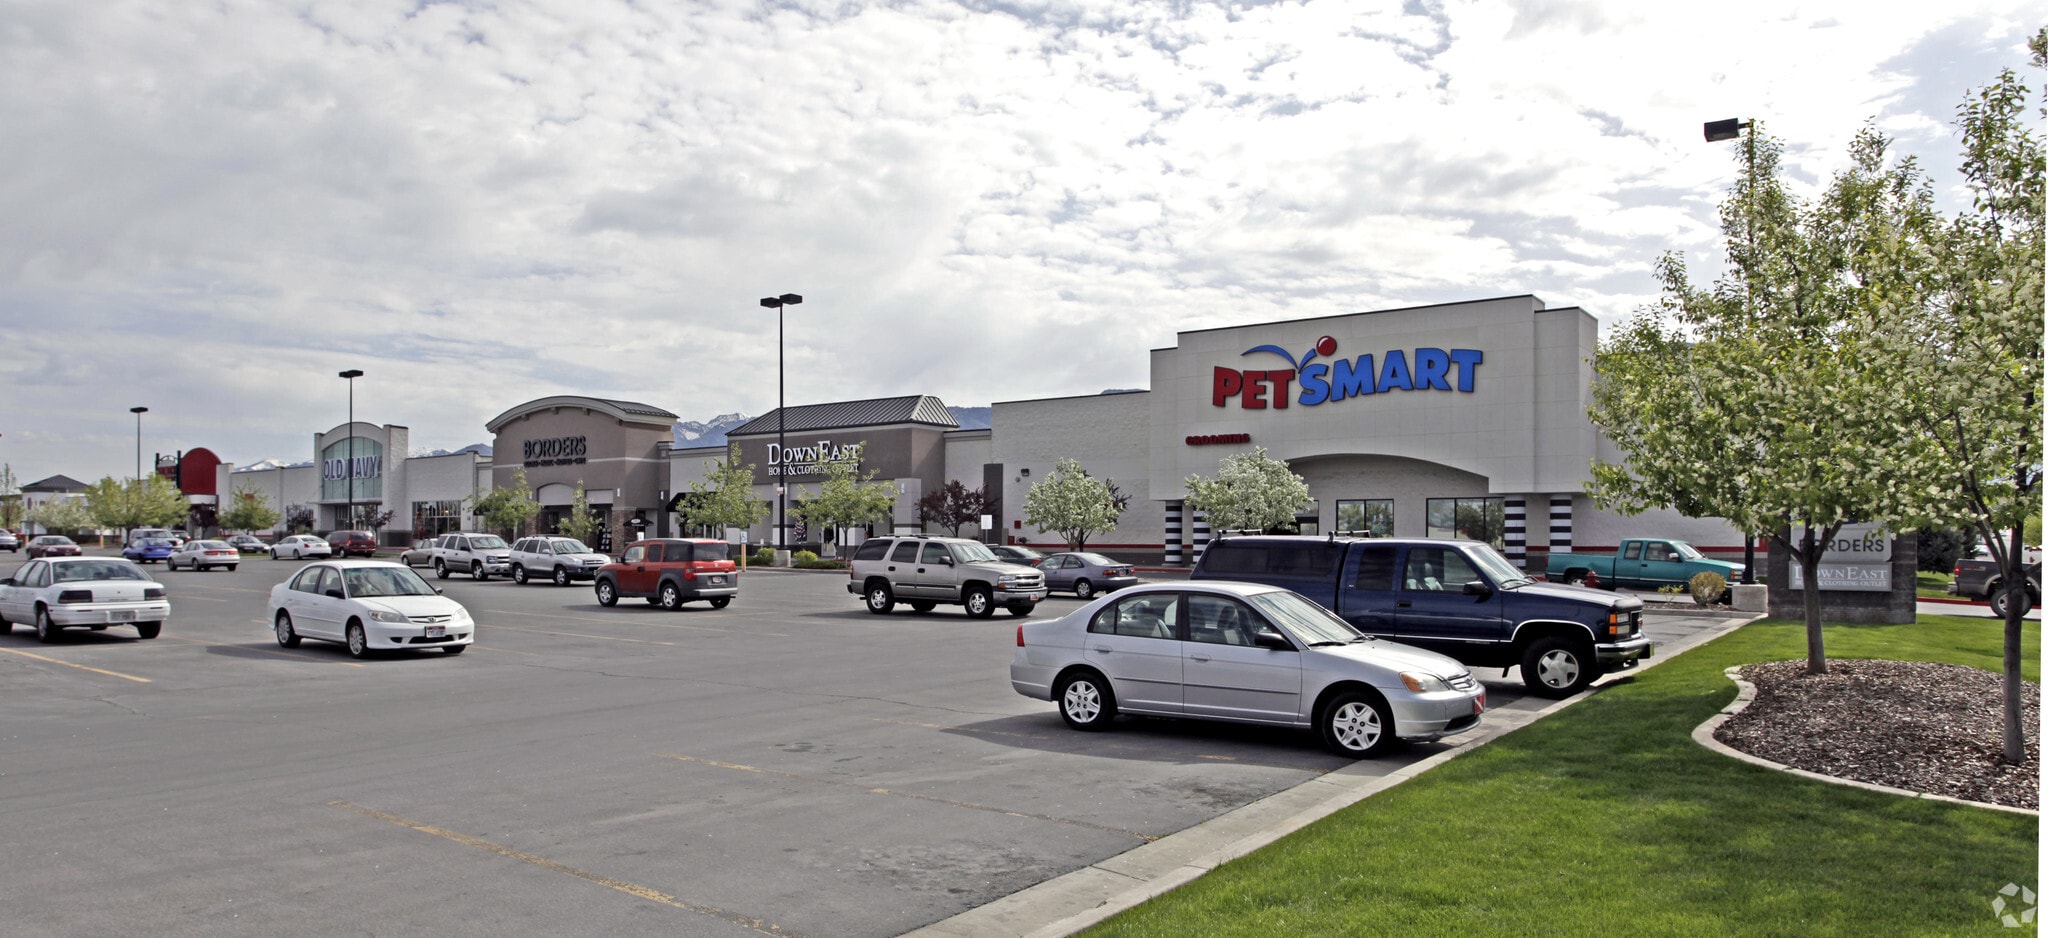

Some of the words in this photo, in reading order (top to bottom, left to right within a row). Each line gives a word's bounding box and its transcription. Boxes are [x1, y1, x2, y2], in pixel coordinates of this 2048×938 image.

[1213, 347, 1483, 409] PETSMART
[1185, 433, 1251, 446] GROOMING
[523, 435, 587, 459] BORDERS
[323, 458, 345, 481] OLD
[788, 463, 796, 476] &
[1799, 539, 1884, 552] RDERS
[1794, 566, 1887, 580] WNEAST
